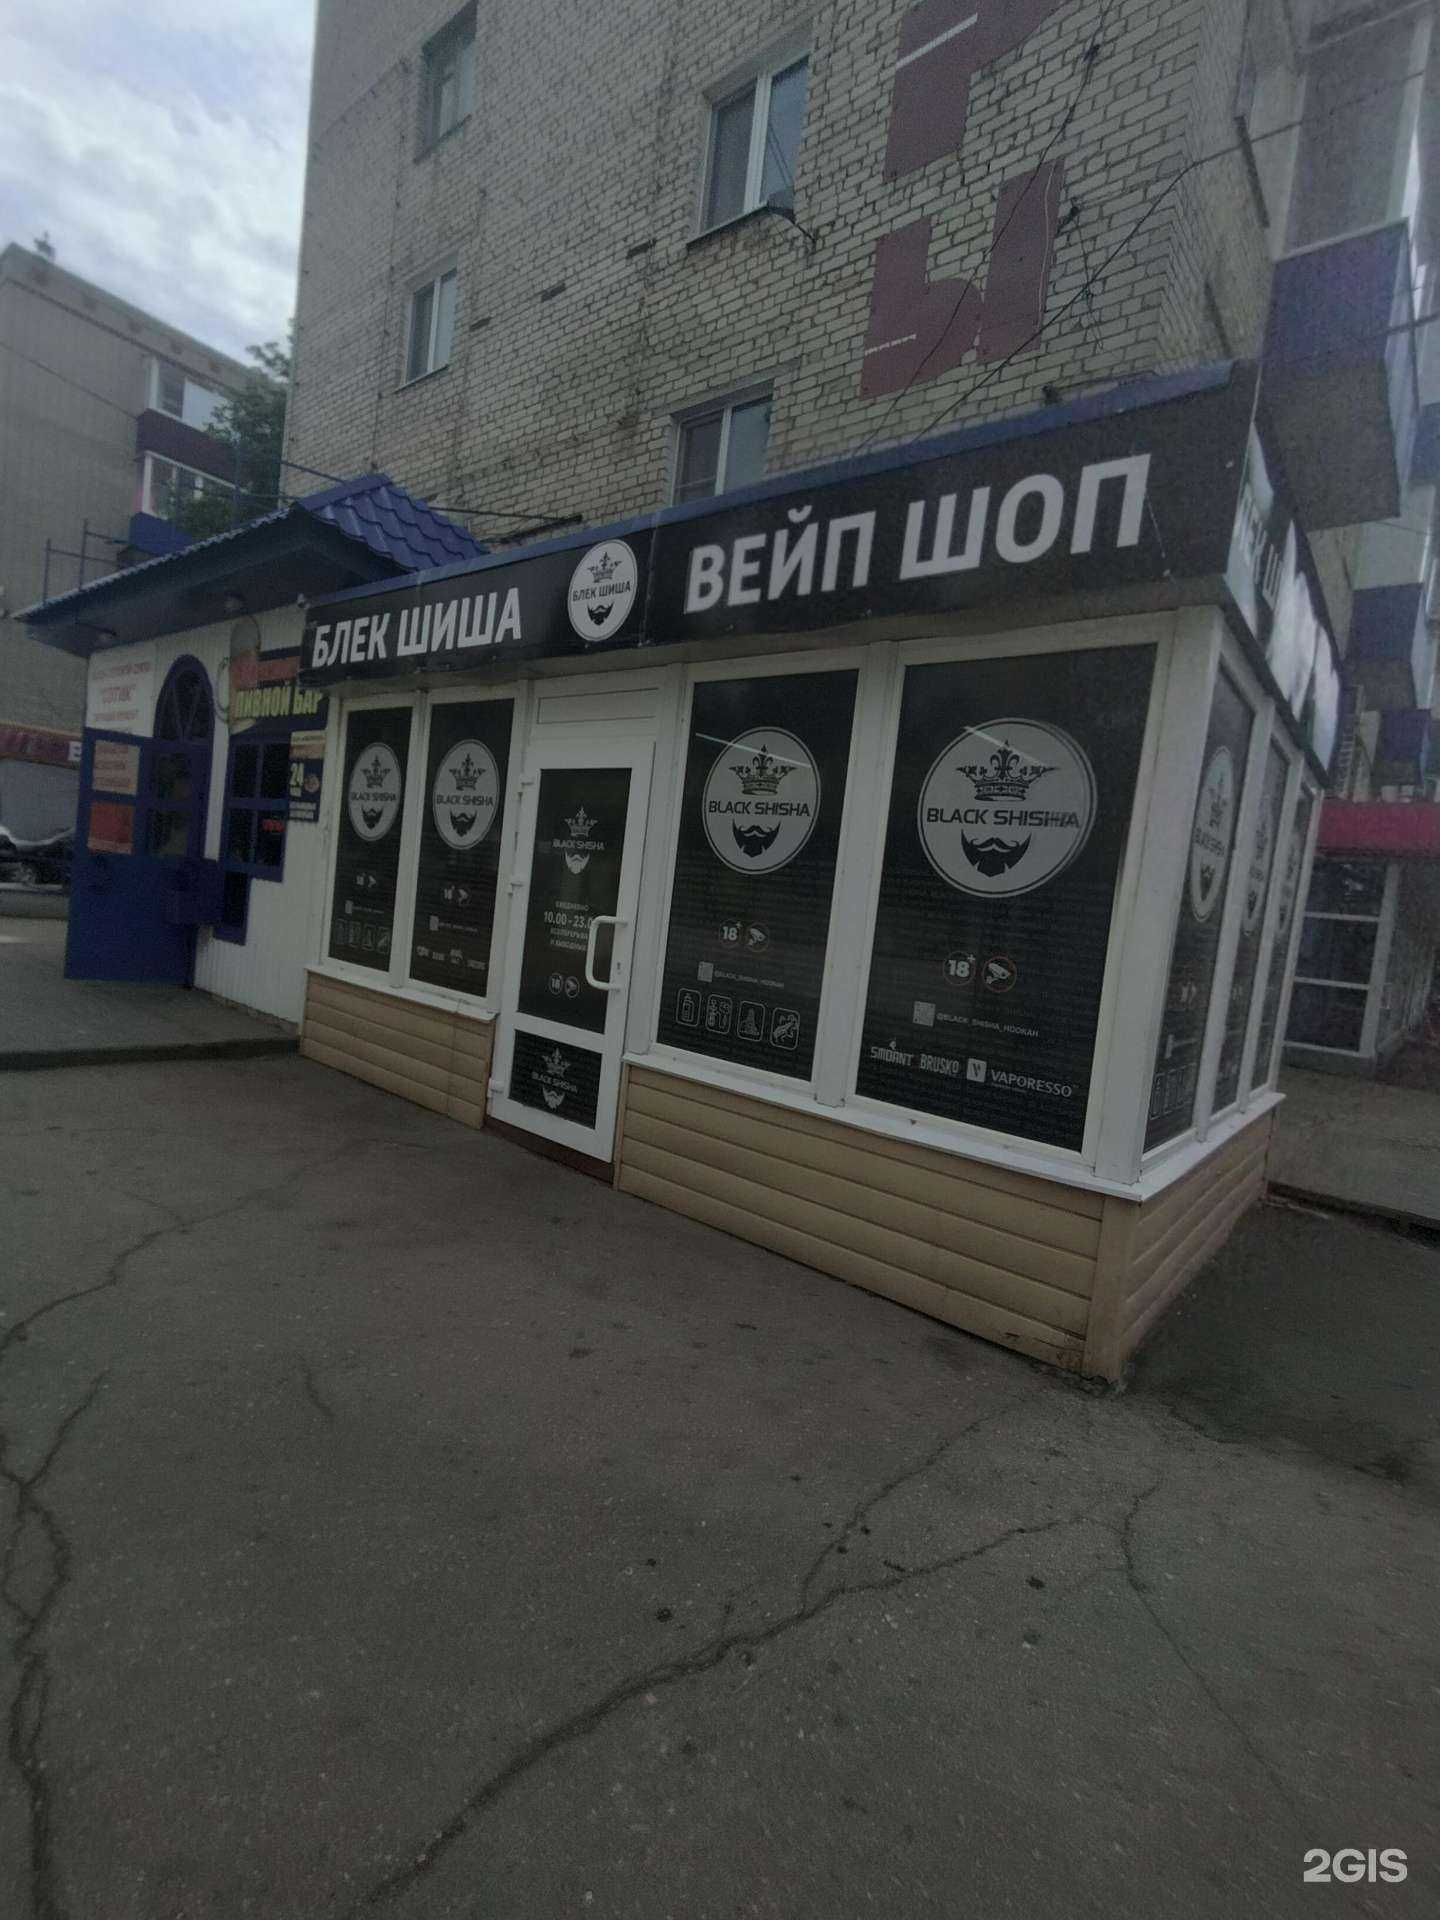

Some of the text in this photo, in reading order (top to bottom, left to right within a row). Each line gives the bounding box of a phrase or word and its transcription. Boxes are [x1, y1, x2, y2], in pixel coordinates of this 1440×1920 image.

[684, 504, 877, 615] ВЕЙП
[899, 453, 1152, 581] ШОП
[572, 581, 631, 601] БЛЕК ШИША
[312, 587, 522, 669] БЛЕК ШИША
[436, 794, 494, 806] BLACK SHISHA
[709, 800, 810, 817] BLACK SHISHA
[926, 808, 1081, 829] BLACK SHISHA
[991, 1069, 1073, 1099] VAPORESSO
